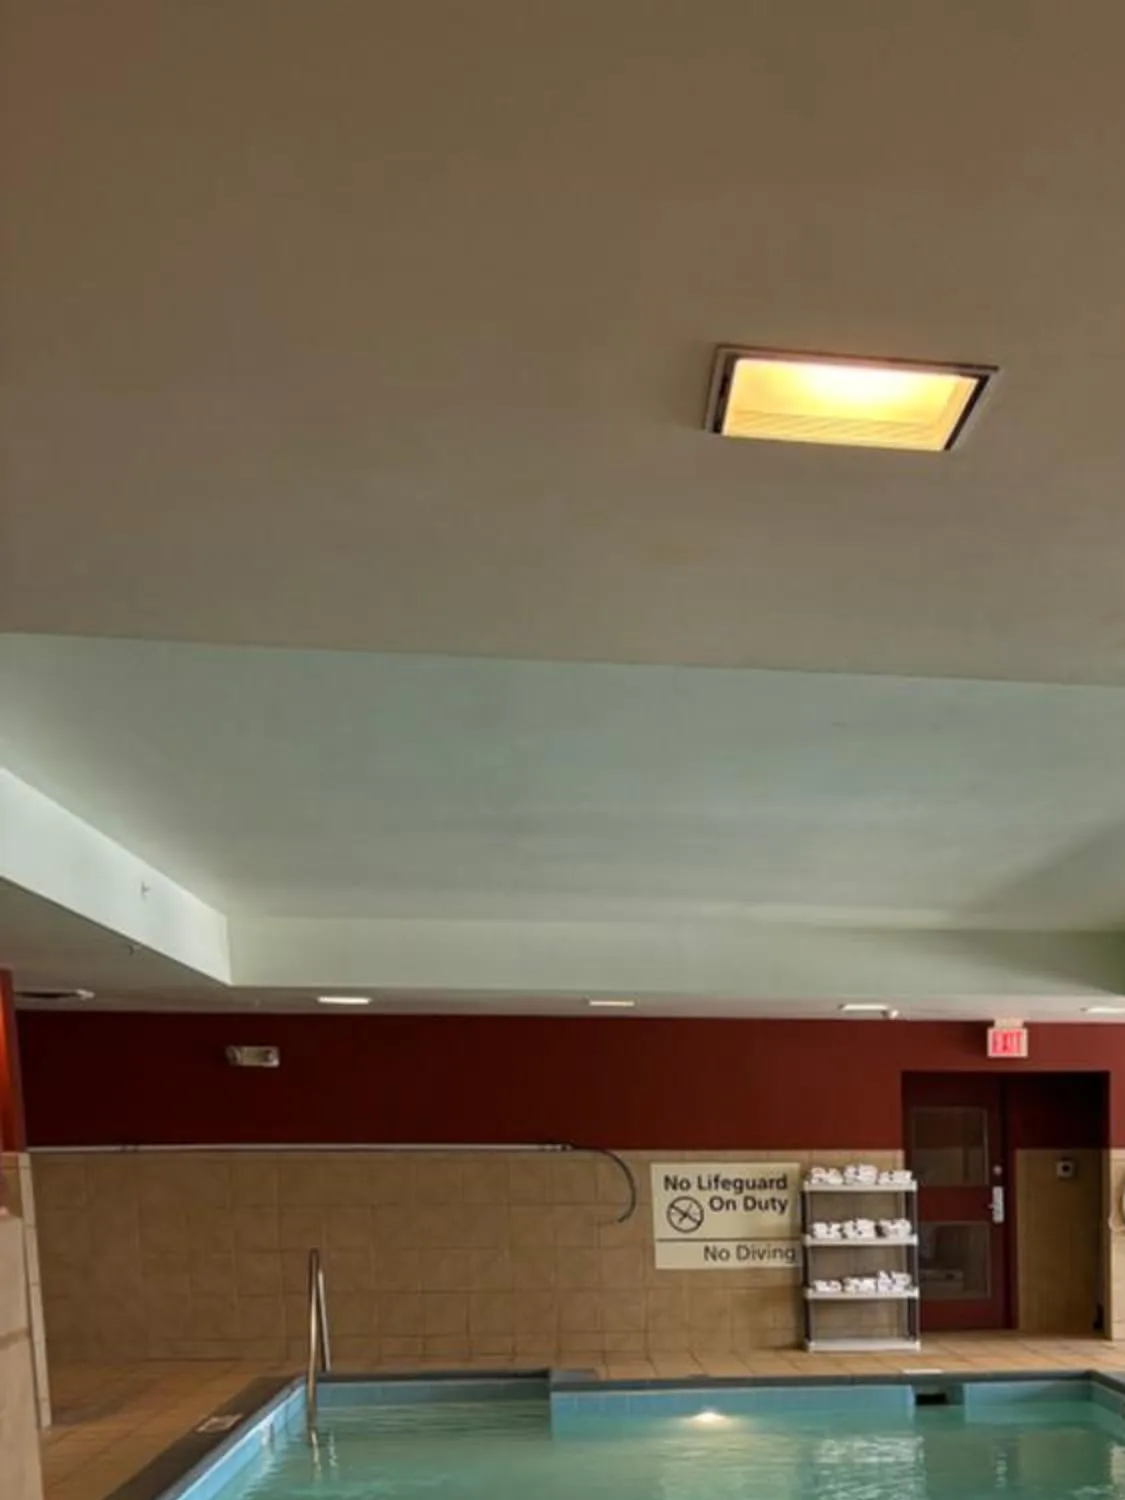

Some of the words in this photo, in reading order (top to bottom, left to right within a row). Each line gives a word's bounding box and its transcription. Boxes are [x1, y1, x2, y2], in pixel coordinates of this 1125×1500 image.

[663, 1174, 691, 1191] No
[697, 1173, 788, 1194] Lifeguard
[709, 1196, 737, 1212] On
[743, 1195, 789, 1214] Duty
[703, 1245, 740, 1262] No
[746, 1245, 796, 1264] Diving
